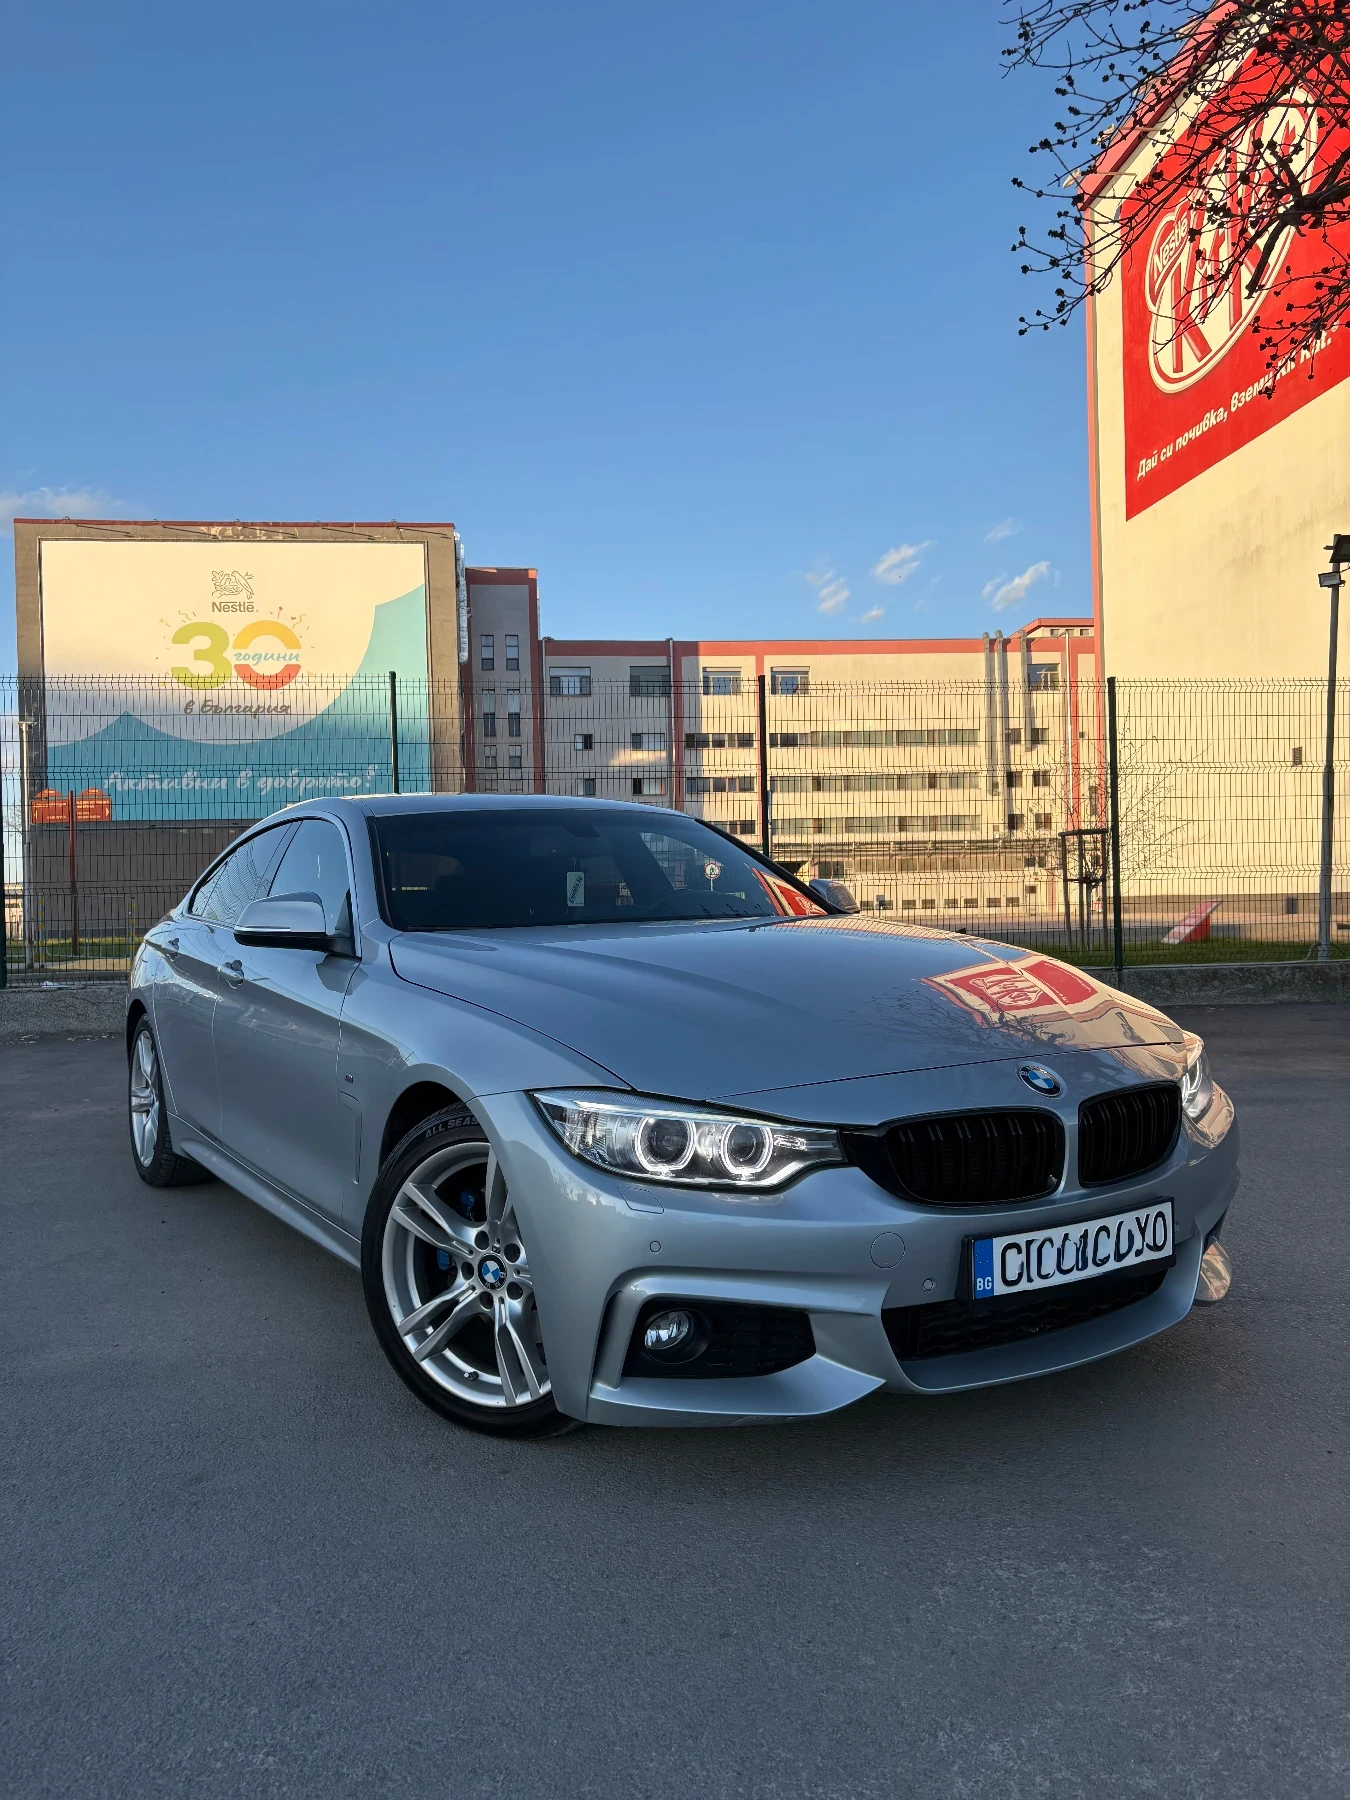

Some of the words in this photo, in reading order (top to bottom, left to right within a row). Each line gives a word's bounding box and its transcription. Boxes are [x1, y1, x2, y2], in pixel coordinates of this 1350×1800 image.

[1154, 211, 1188, 281] Nestlé
[1137, 451, 1158, 481] Дай
[1160, 442, 1173, 462] си
[1175, 406, 1228, 452] почивка,
[1230, 371, 1274, 412] вземи
[212, 601, 255, 613] Nestlé
[171, 620, 302, 690] 30
[233, 652, 300, 667] години
[201, 700, 290, 719] България
[104, 769, 228, 791] Активни
[257, 765, 378, 796] доброто!
[425, 1123, 446, 1139] ALL
[976, 1276, 993, 1291] BG
